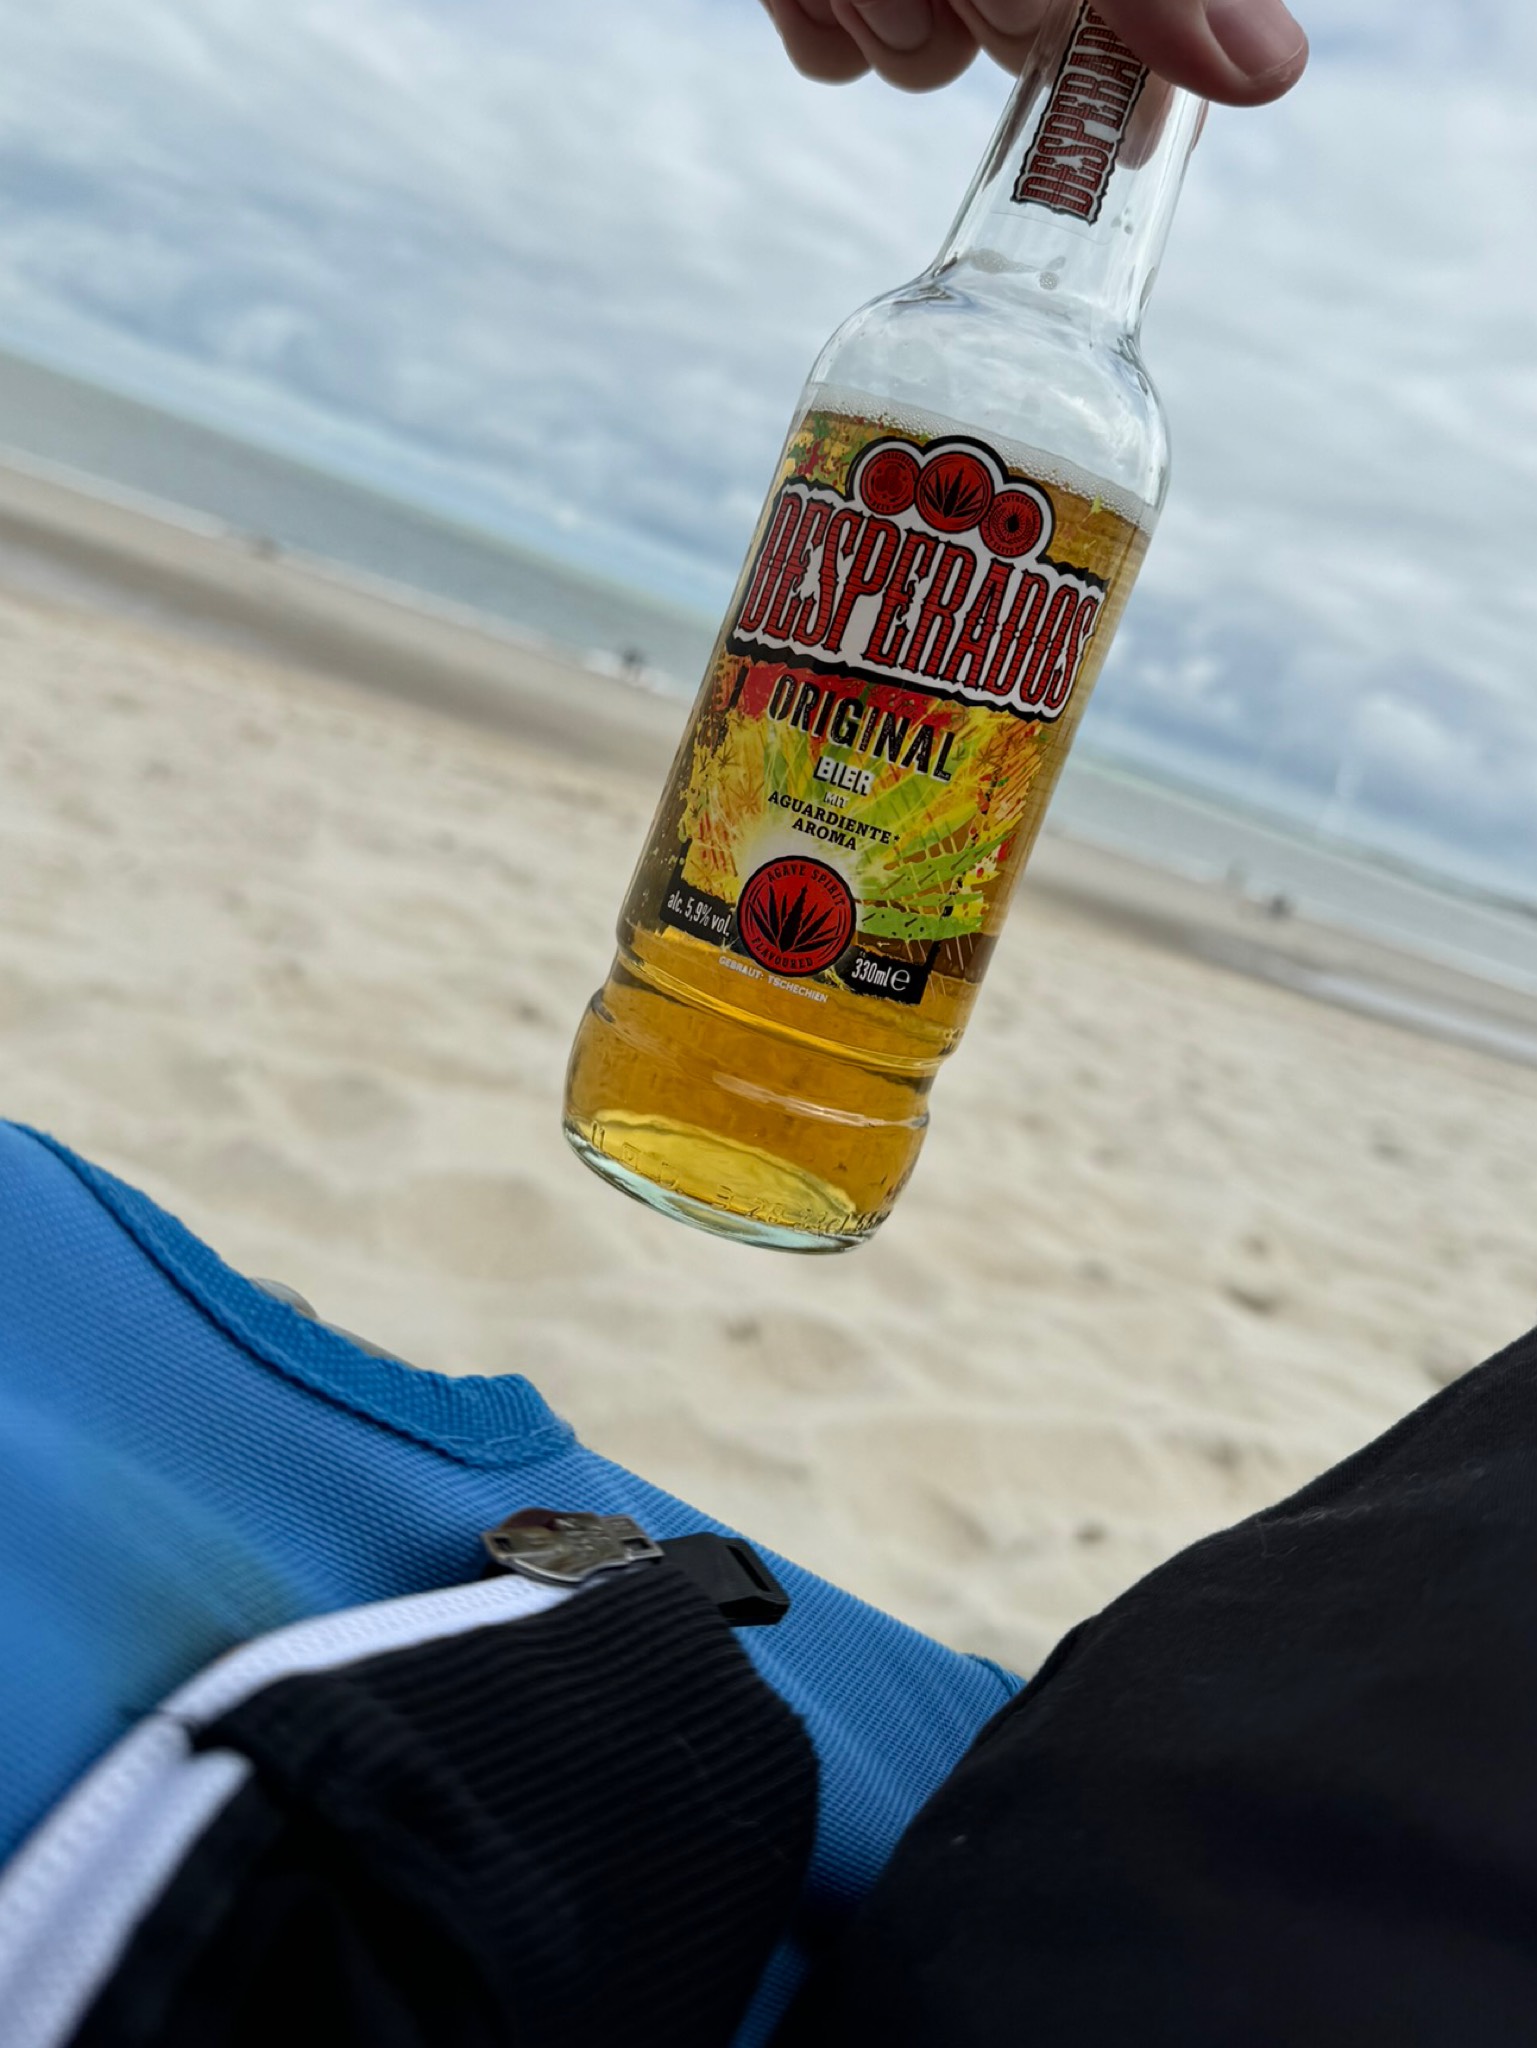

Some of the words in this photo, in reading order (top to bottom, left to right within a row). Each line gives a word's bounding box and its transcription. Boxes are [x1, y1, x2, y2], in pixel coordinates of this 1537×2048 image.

[1020, 4, 1142, 215] DESPERAD
[737, 490, 1099, 710] DESPERADOS
[767, 673, 955, 783] ORIGINAL
[813, 756, 875, 797] BIER
[823, 791, 850, 809] MIT
[792, 817, 857, 851] AROMA
[766, 864, 807, 882] AGAVE
[811, 868, 846, 907] SPIRIT
[667, 890, 683, 914] alc.
[684, 896, 712, 927] 5,9%
[711, 914, 732, 937] vol.
[750, 937, 814, 969] FLAVOURED
[851, 957, 892, 988] 330ml
[719, 955, 764, 980] GEBRAUT:
[767, 974, 829, 1003] TSCHECHIEN
